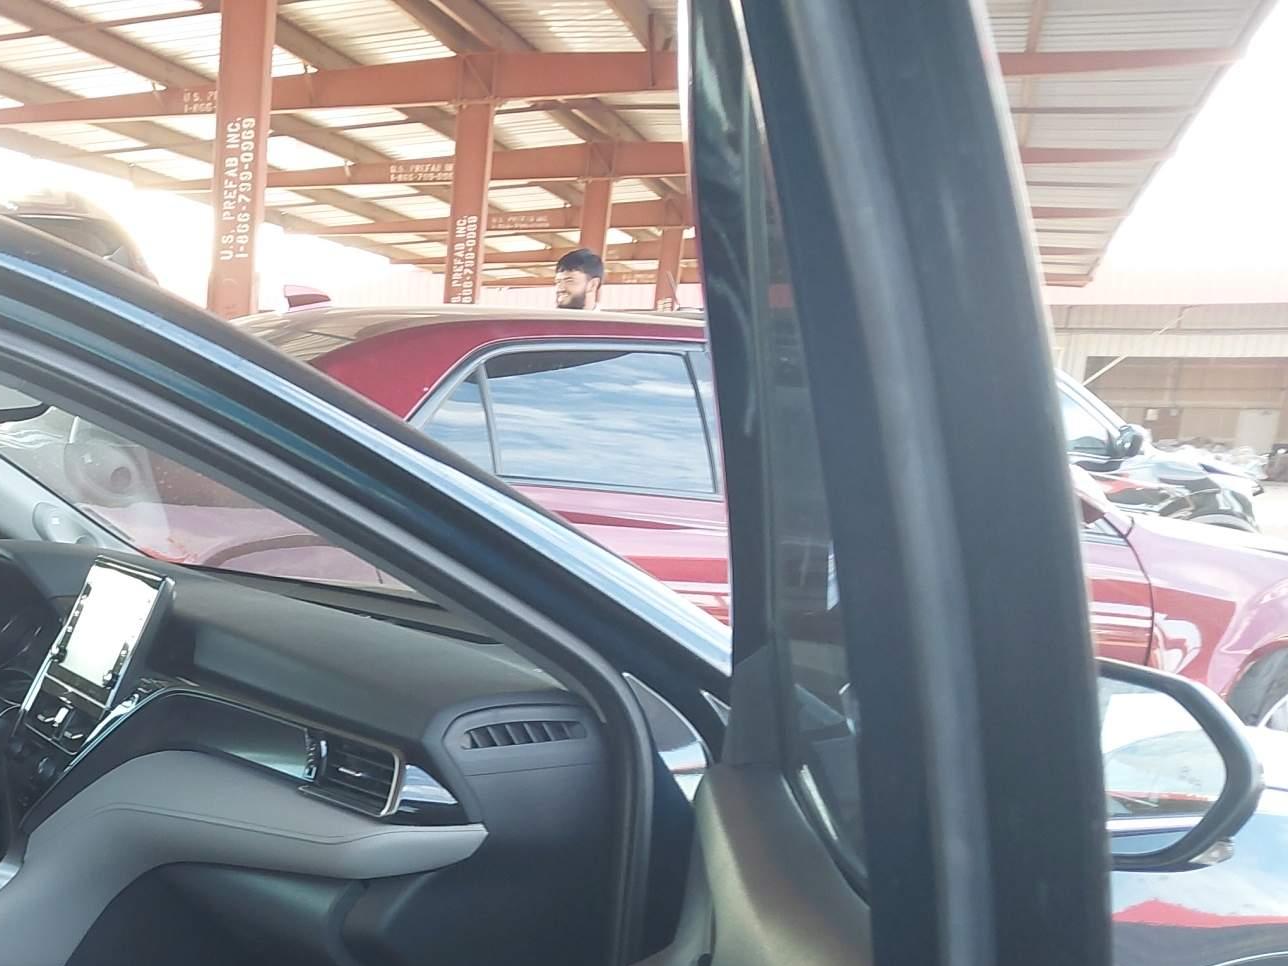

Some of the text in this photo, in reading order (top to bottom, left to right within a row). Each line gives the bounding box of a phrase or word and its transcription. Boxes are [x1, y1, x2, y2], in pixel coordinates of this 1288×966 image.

[219, 116, 242, 261] U.S. PREFAB INC.
[234, 117, 256, 259] 1-866-799-0969
